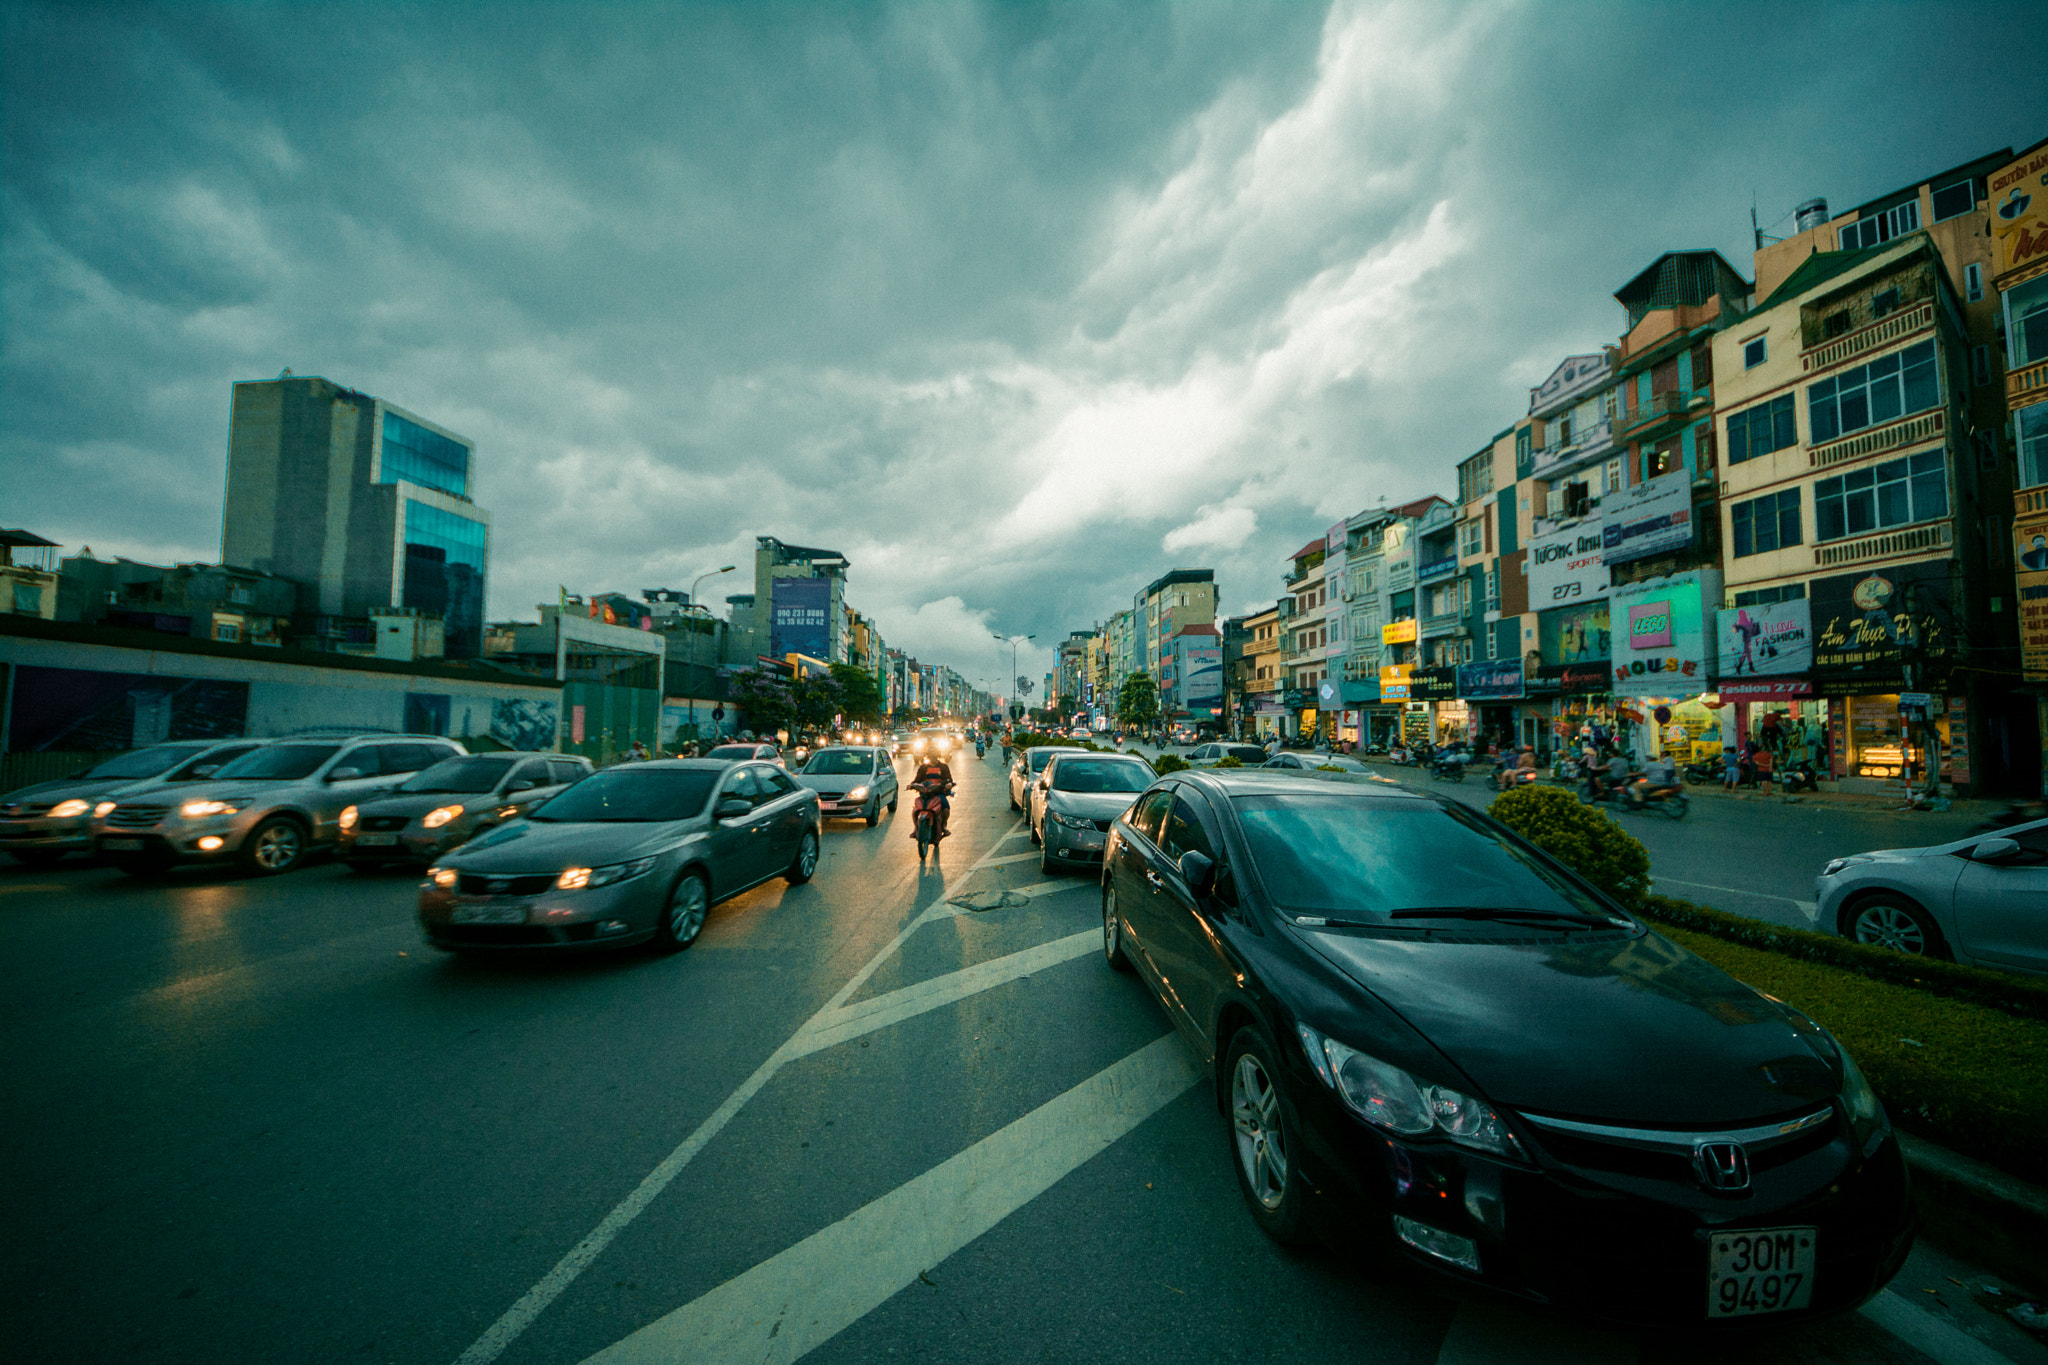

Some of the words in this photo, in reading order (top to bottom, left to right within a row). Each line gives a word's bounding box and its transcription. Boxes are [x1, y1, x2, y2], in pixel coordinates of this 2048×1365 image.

[1566, 555, 1602, 571] SPORTS
[1553, 581, 1581, 600] 273
[1633, 615, 1668, 635] LEGO
[1771, 619, 1797, 634] LOVE
[1755, 628, 1805, 647] FASHION
[1615, 658, 1698, 681] HOUSE
[1717, 684, 1771, 694] Fashion
[1774, 682, 1809, 693] 277
[1731, 1234, 1795, 1272] 30M
[1719, 1273, 1803, 1313] 9497
